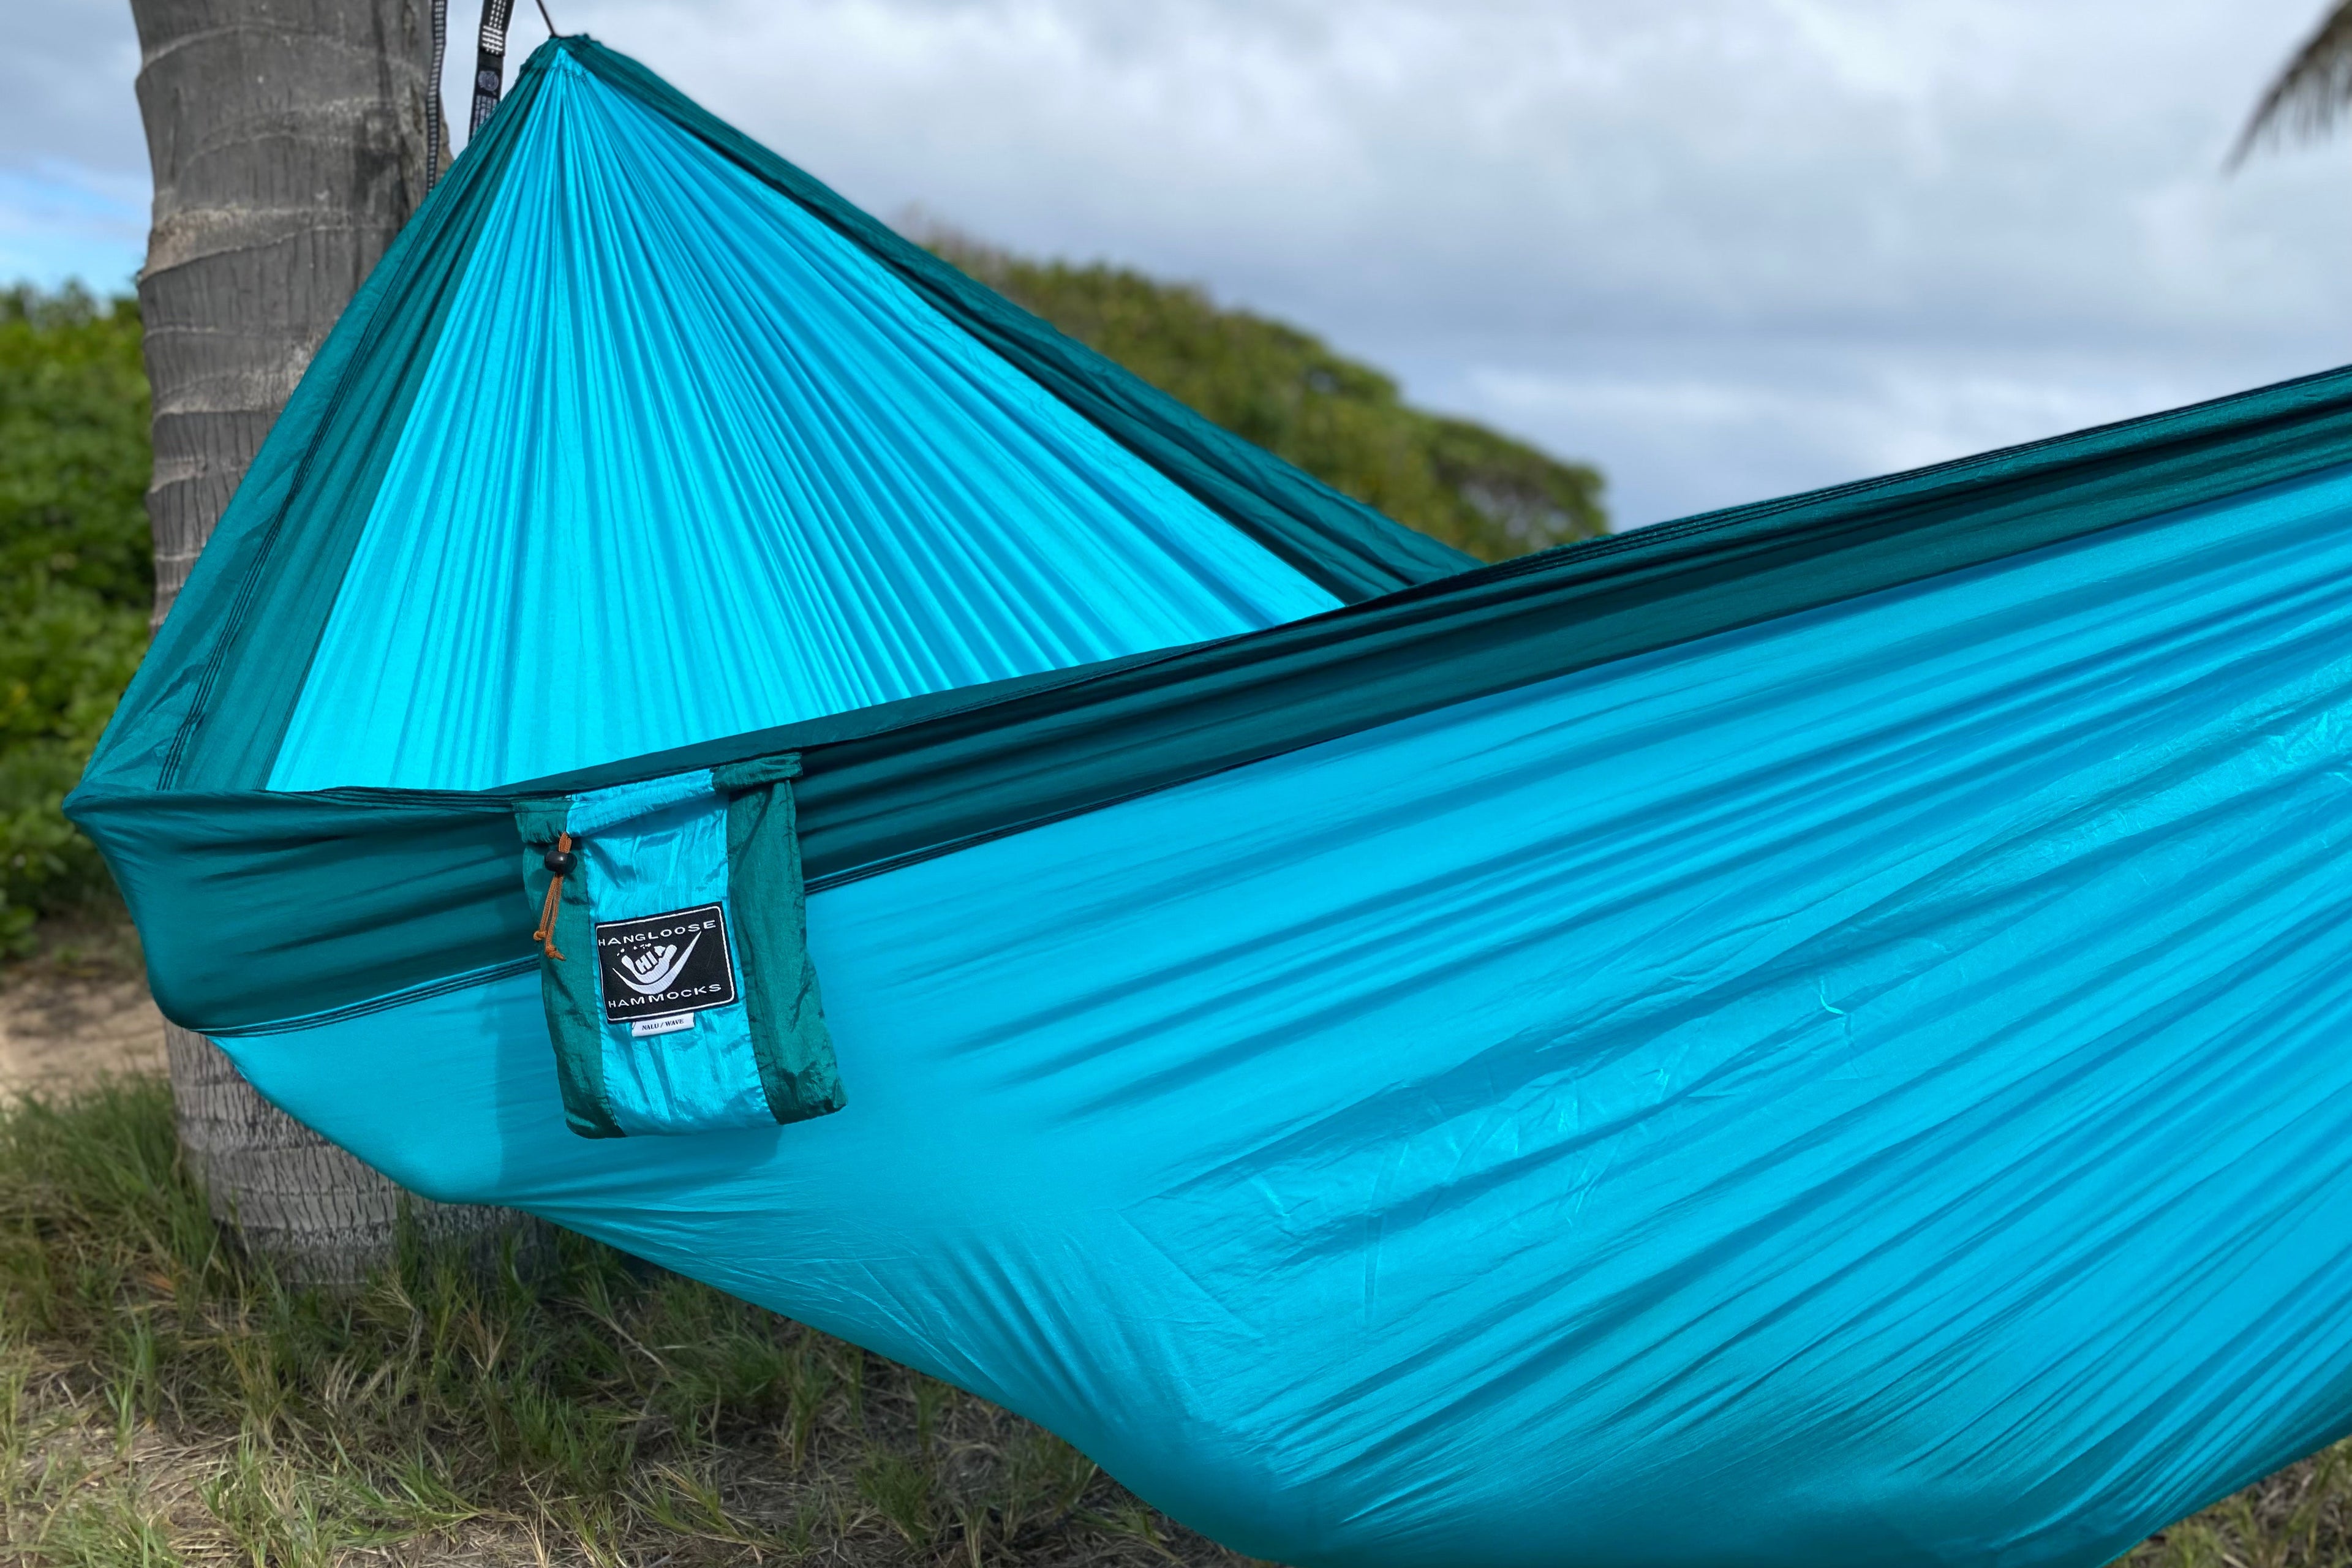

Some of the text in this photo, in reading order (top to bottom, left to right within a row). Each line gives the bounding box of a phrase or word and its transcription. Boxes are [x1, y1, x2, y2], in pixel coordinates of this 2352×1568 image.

[598, 919, 716, 946] HANGLOOSE
[608, 983, 722, 1008] HAMMOCKS
[665, 1018, 684, 1028] WAVE
